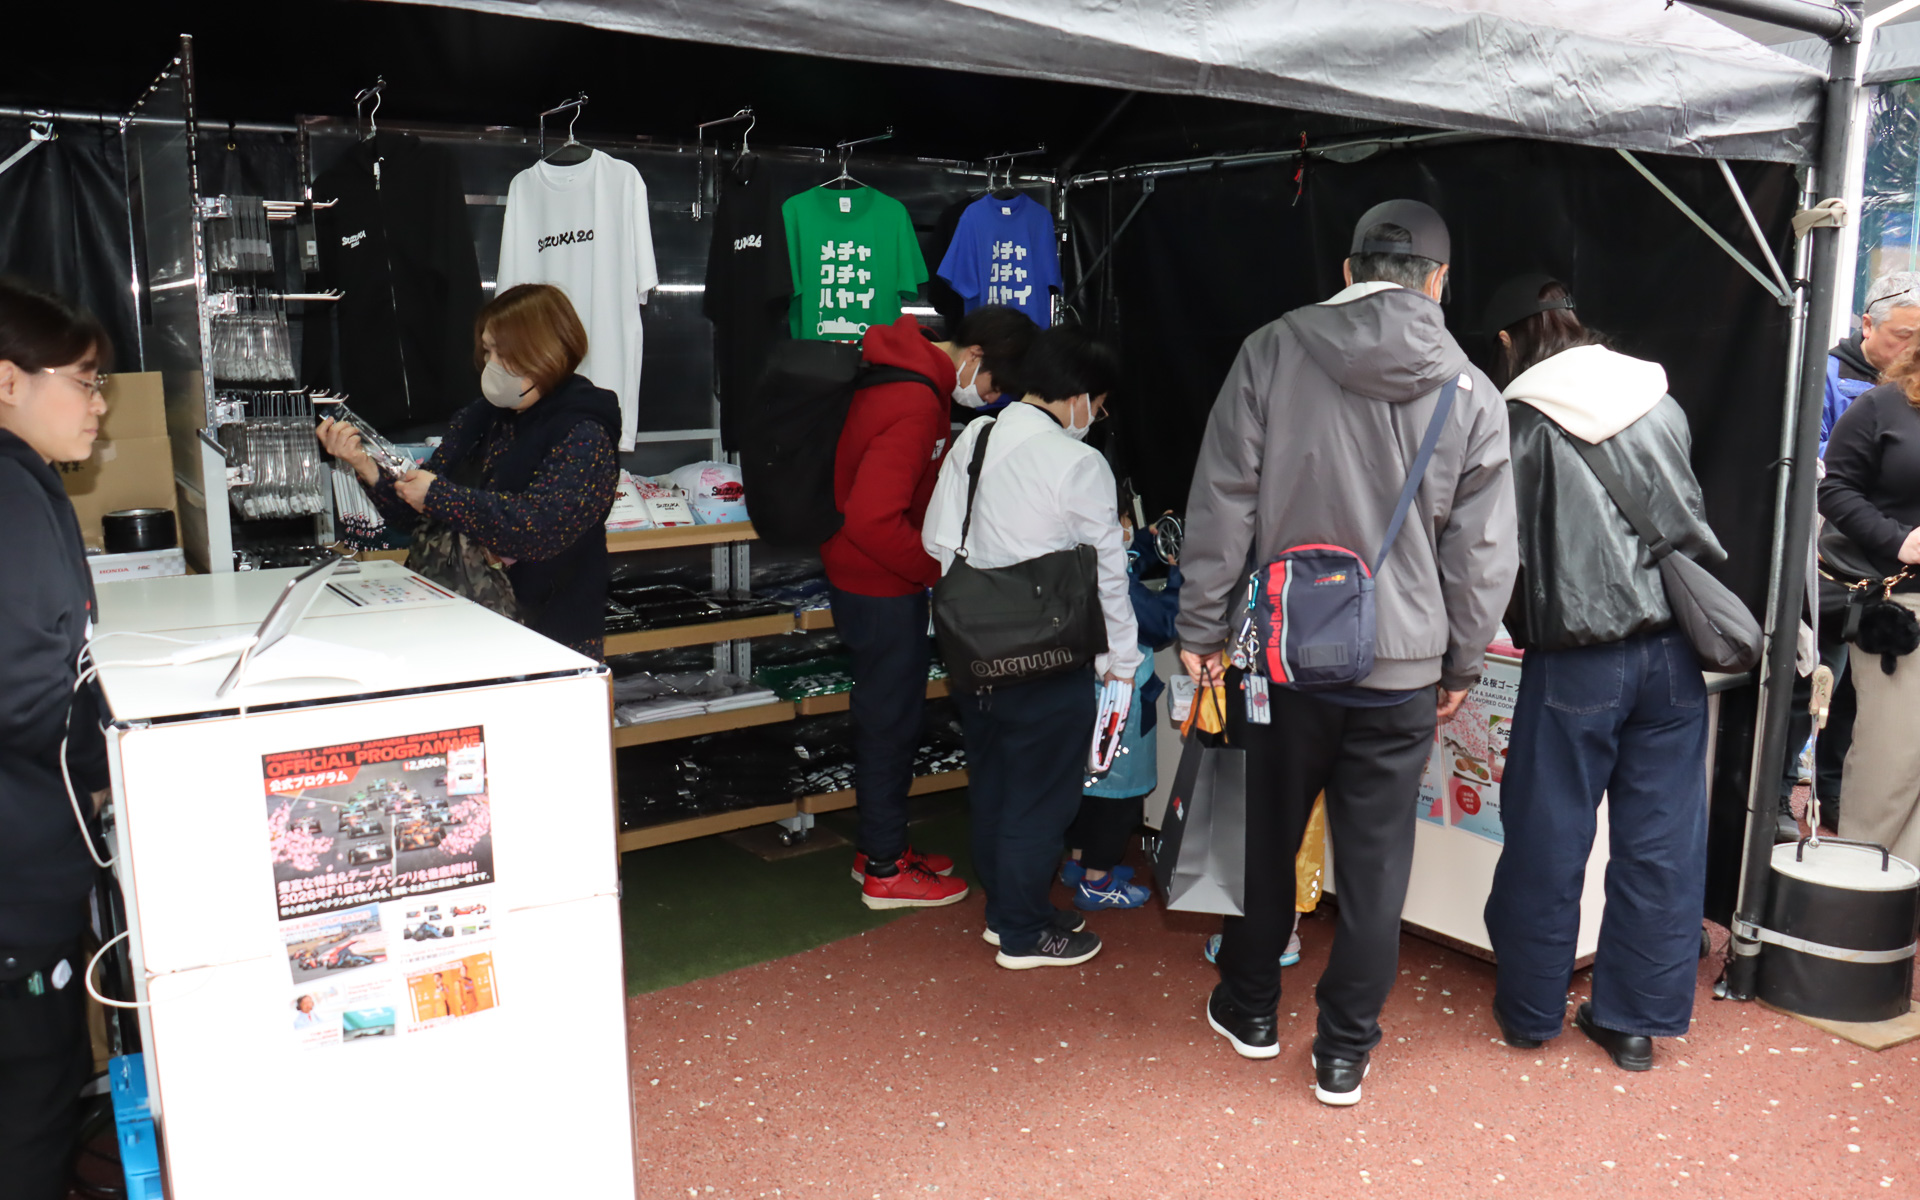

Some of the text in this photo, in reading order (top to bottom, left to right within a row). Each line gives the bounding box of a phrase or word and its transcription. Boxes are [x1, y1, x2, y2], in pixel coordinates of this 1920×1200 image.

[820, 240, 872, 262] メチャ
[992, 240, 1028, 261] メチャ
[820, 263, 872, 285] クチャ
[990, 262, 1028, 283] クチャ
[819, 287, 876, 309] ハヤイ
[987, 285, 1033, 306] ハヤイ
[99, 567, 130, 575] HONDA
[970, 647, 1073, 678] umbro
[1469, 696, 1497, 707] FLAVORED
[1485, 691, 1507, 702] SAKURA
[266, 734, 480, 777] OFFICIAL PROGRAMME
[269, 770, 349, 792] 公式プログラム
